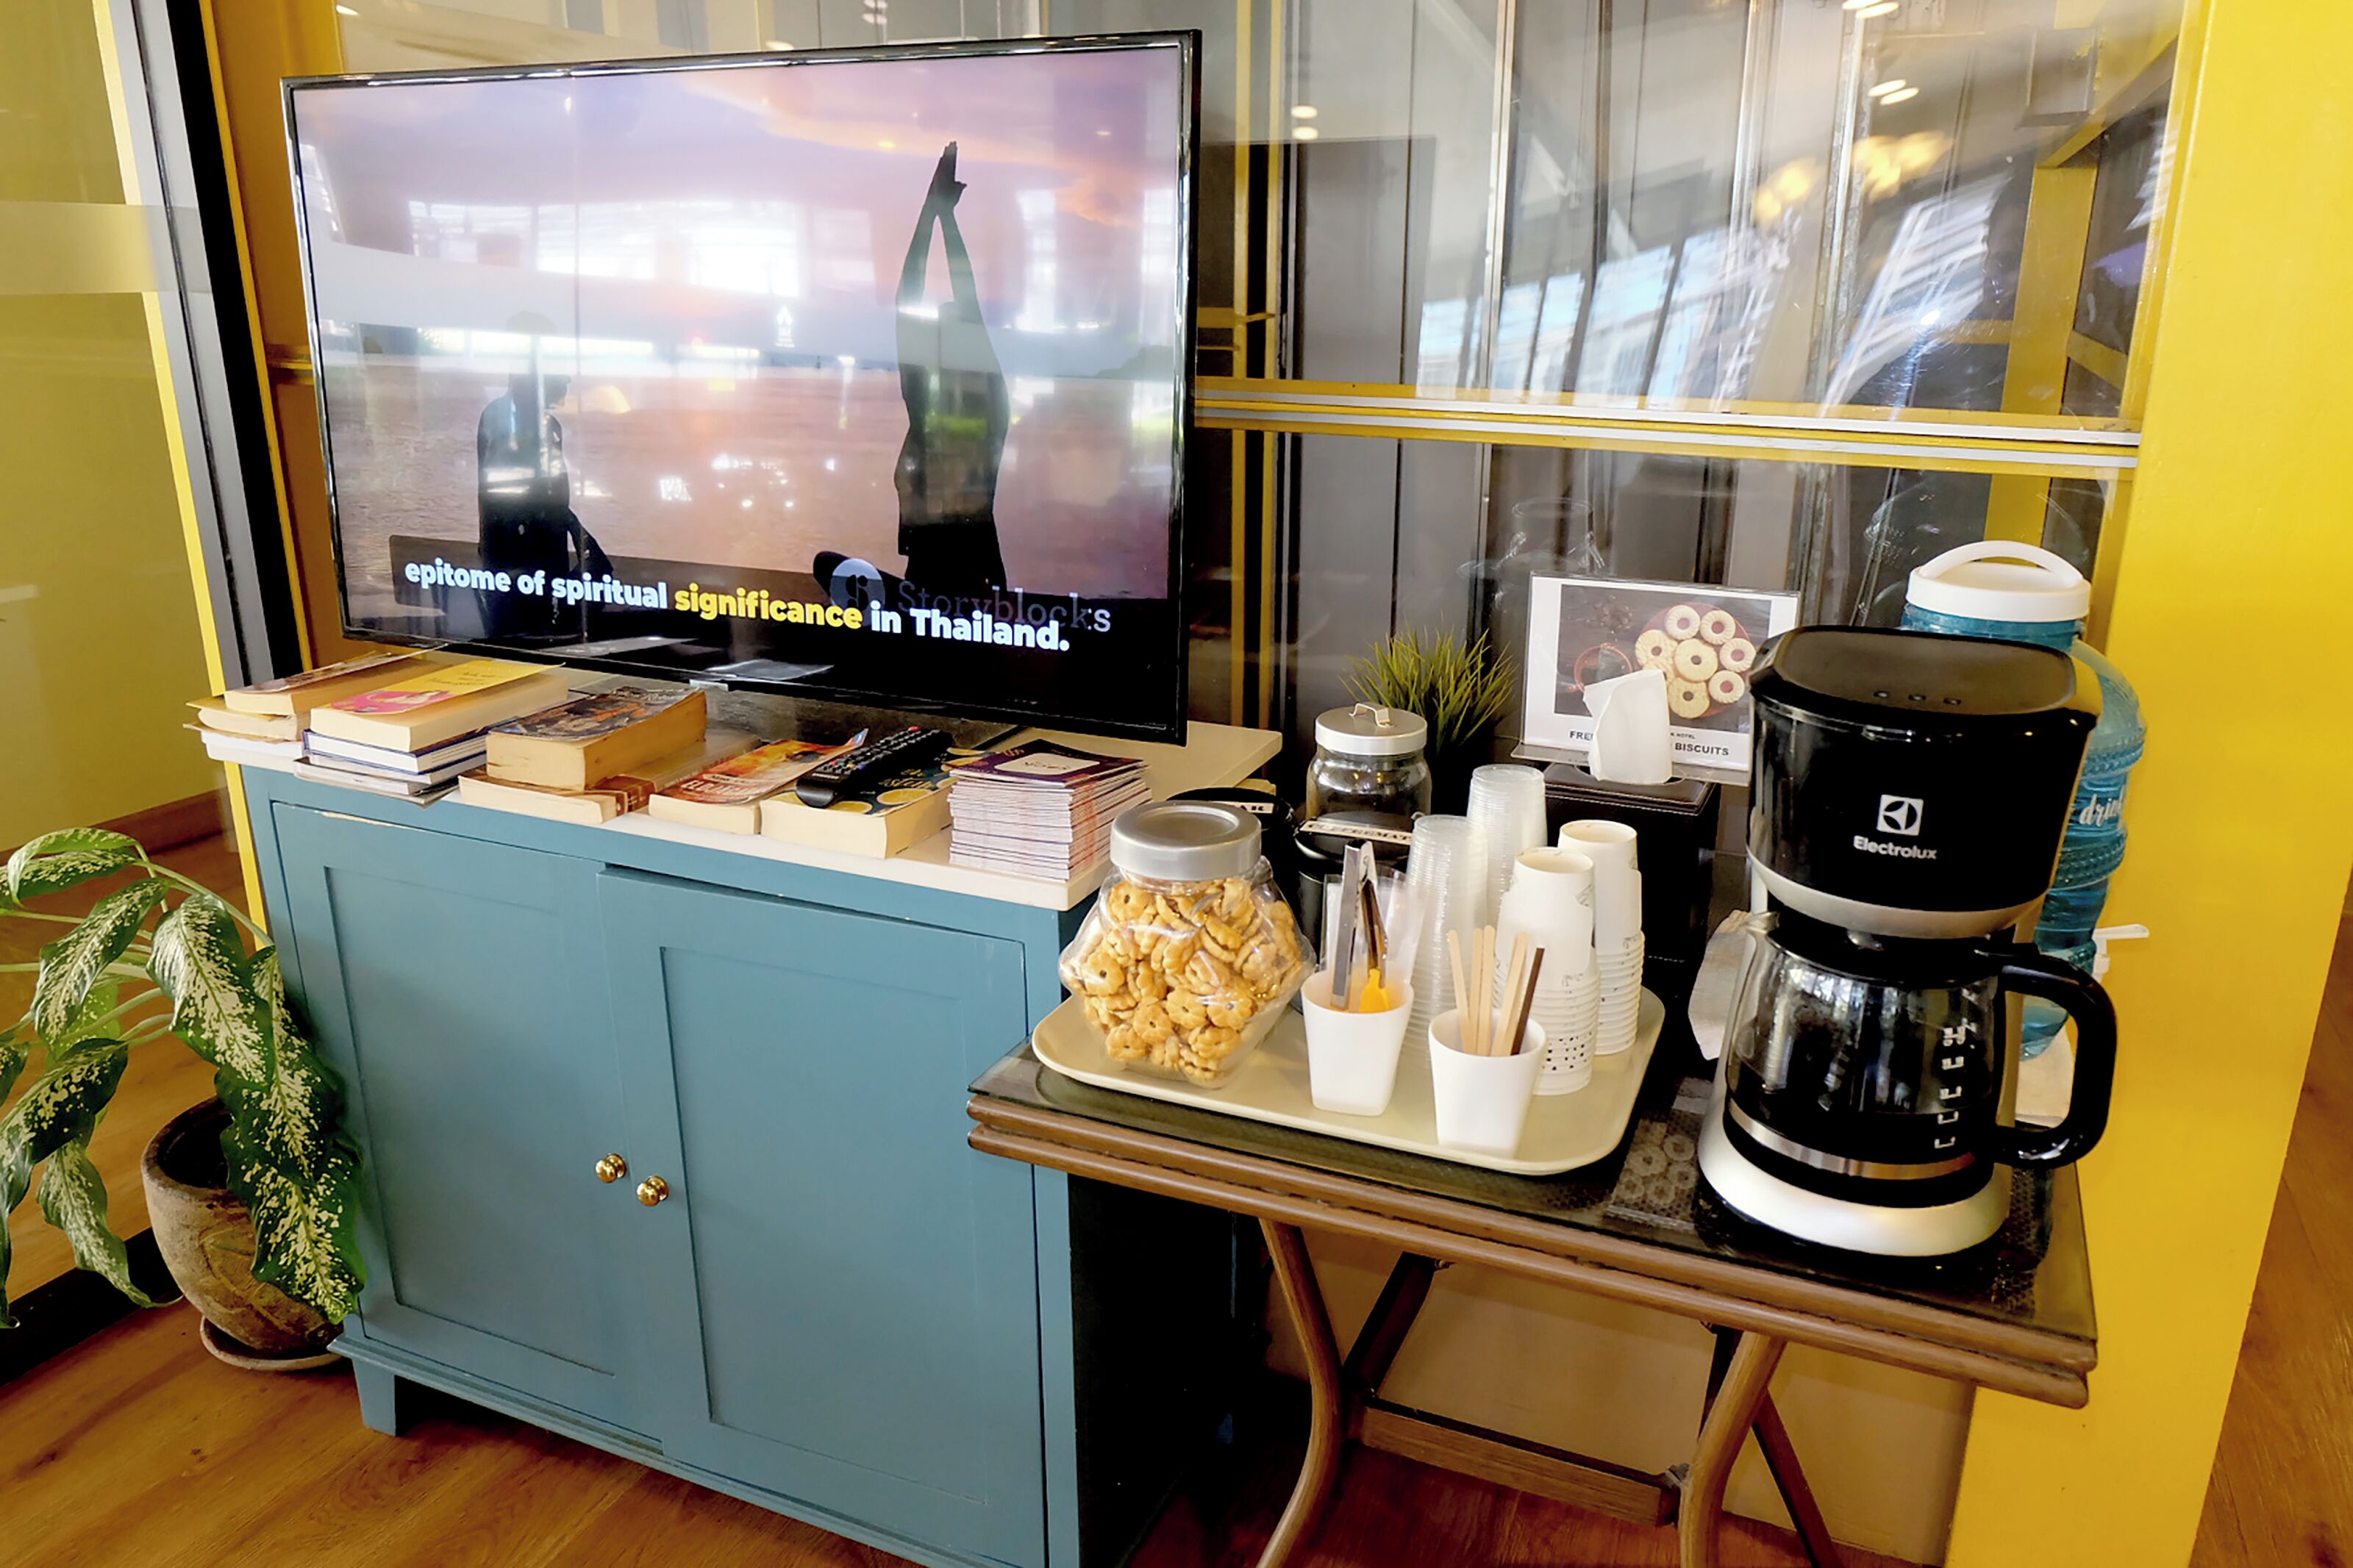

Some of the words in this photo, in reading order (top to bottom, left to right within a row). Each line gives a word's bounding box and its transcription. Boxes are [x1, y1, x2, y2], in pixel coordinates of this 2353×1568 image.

[404, 558, 511, 593] epitome
[517, 570, 546, 595] of
[551, 573, 668, 609] spiritual
[674, 581, 863, 629] significance
[871, 600, 901, 634] in
[910, 607, 1070, 652] Thailand.
[1674, 742, 1729, 756] BISCUITS
[1853, 834, 1938, 859] Electrolux
